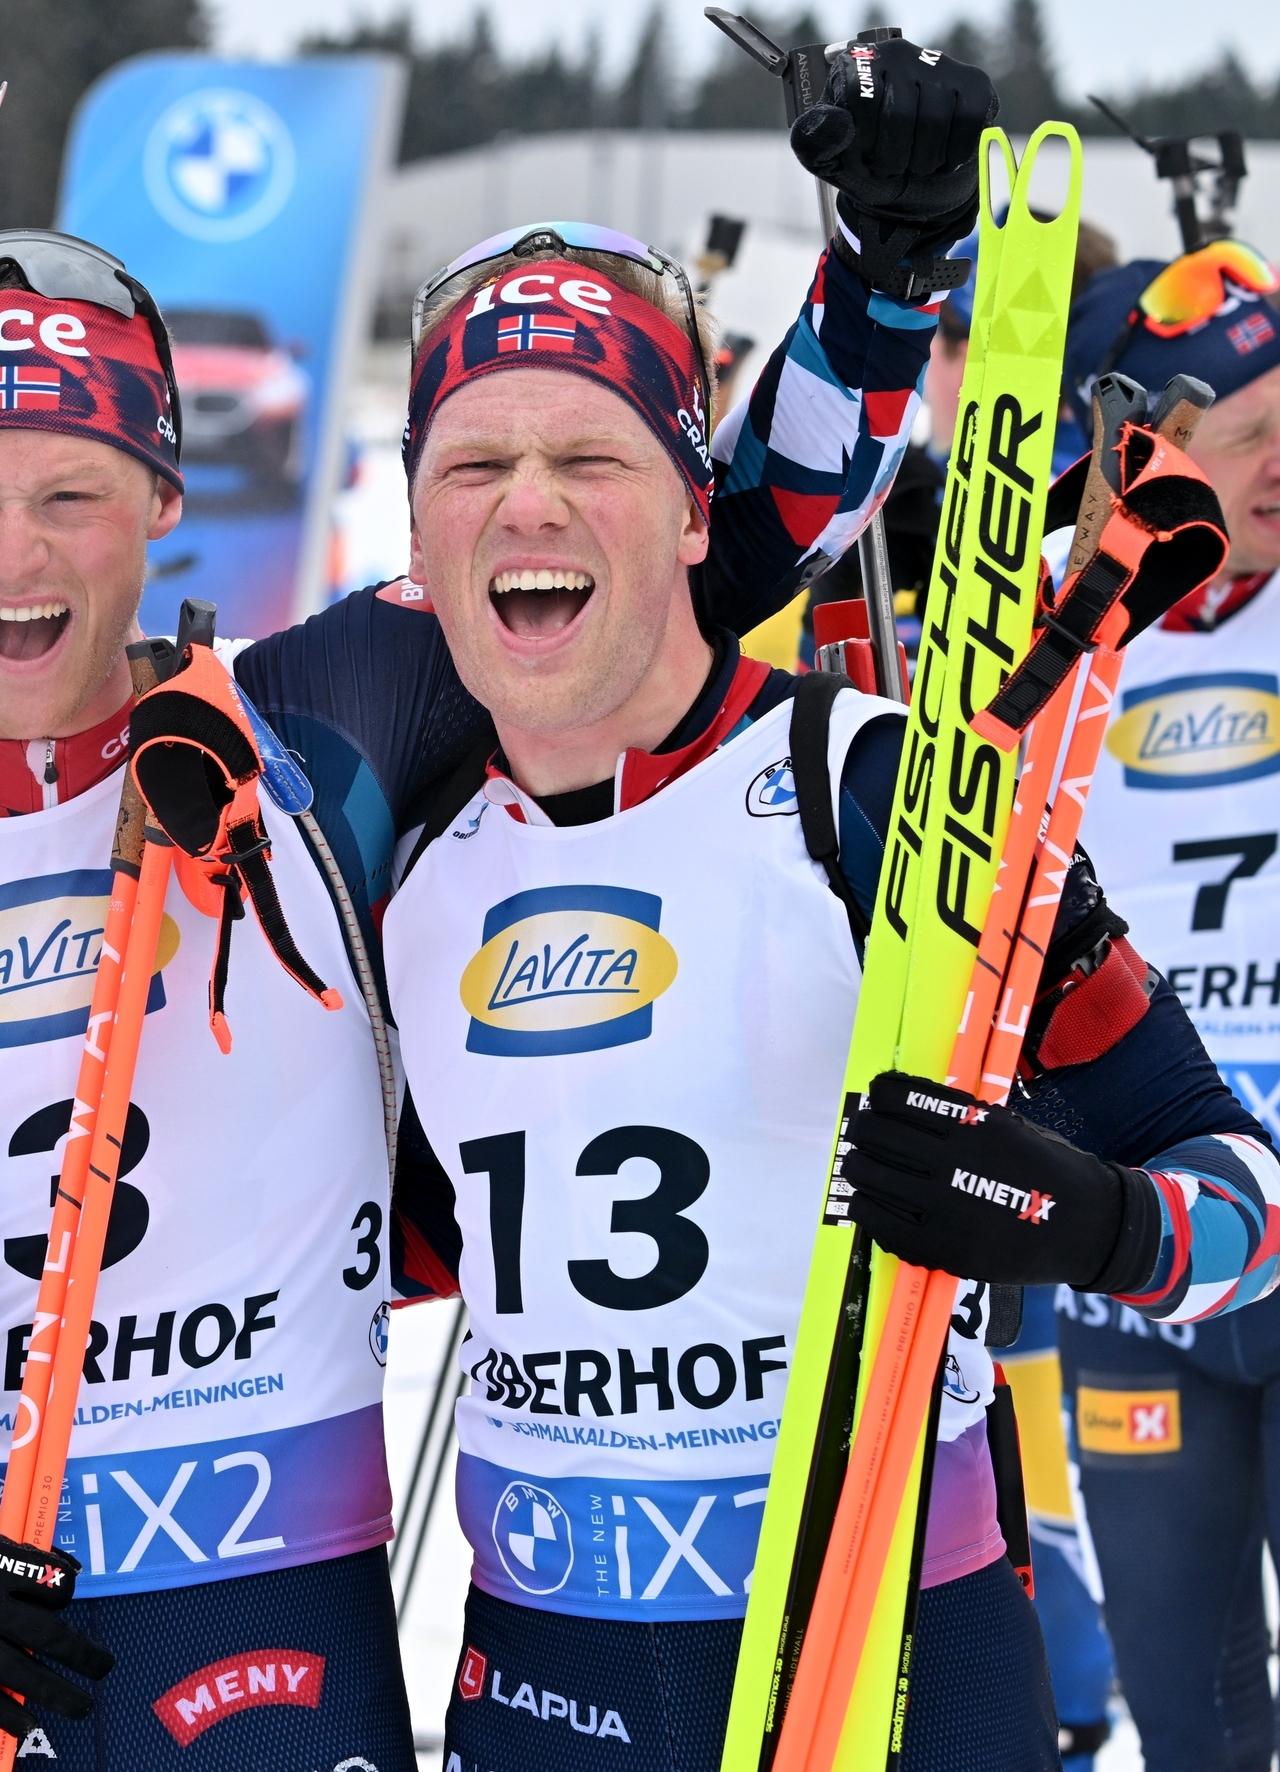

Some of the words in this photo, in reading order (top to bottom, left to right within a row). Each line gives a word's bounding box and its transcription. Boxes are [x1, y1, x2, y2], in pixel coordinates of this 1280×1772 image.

[466, 274, 612, 321] ice
[885, 400, 978, 942] FISCHER
[936, 393, 1043, 949] FISCHER
[1173, 832, 1277, 932] 7
[488, 934, 638, 1010] LAVITA
[4, 1097, 150, 1282] 3
[458, 1125, 711, 1315] 13
[342, 1200, 383, 1291] 3
[470, 1334, 787, 1418] OBERHOF
[510, 1418, 779, 1451] SCHMALKALDEN-MEINING
[33, 1496, 49, 1545] PREMIO
[42, 1475, 53, 1490] 30
[82, 1450, 286, 1576] iX2
[504, 1486, 562, 1520] BMW
[589, 1494, 606, 1542] NEW
[593, 1554, 610, 1597] THE
[901, 1652, 911, 1674] skate
[904, 1634, 913, 1651] plus
[174, 1663, 311, 1726] MENY
[490, 1670, 632, 1745] LAPUA
[898, 1677, 909, 1693] 3D
[891, 1693, 907, 1753] speedmax
